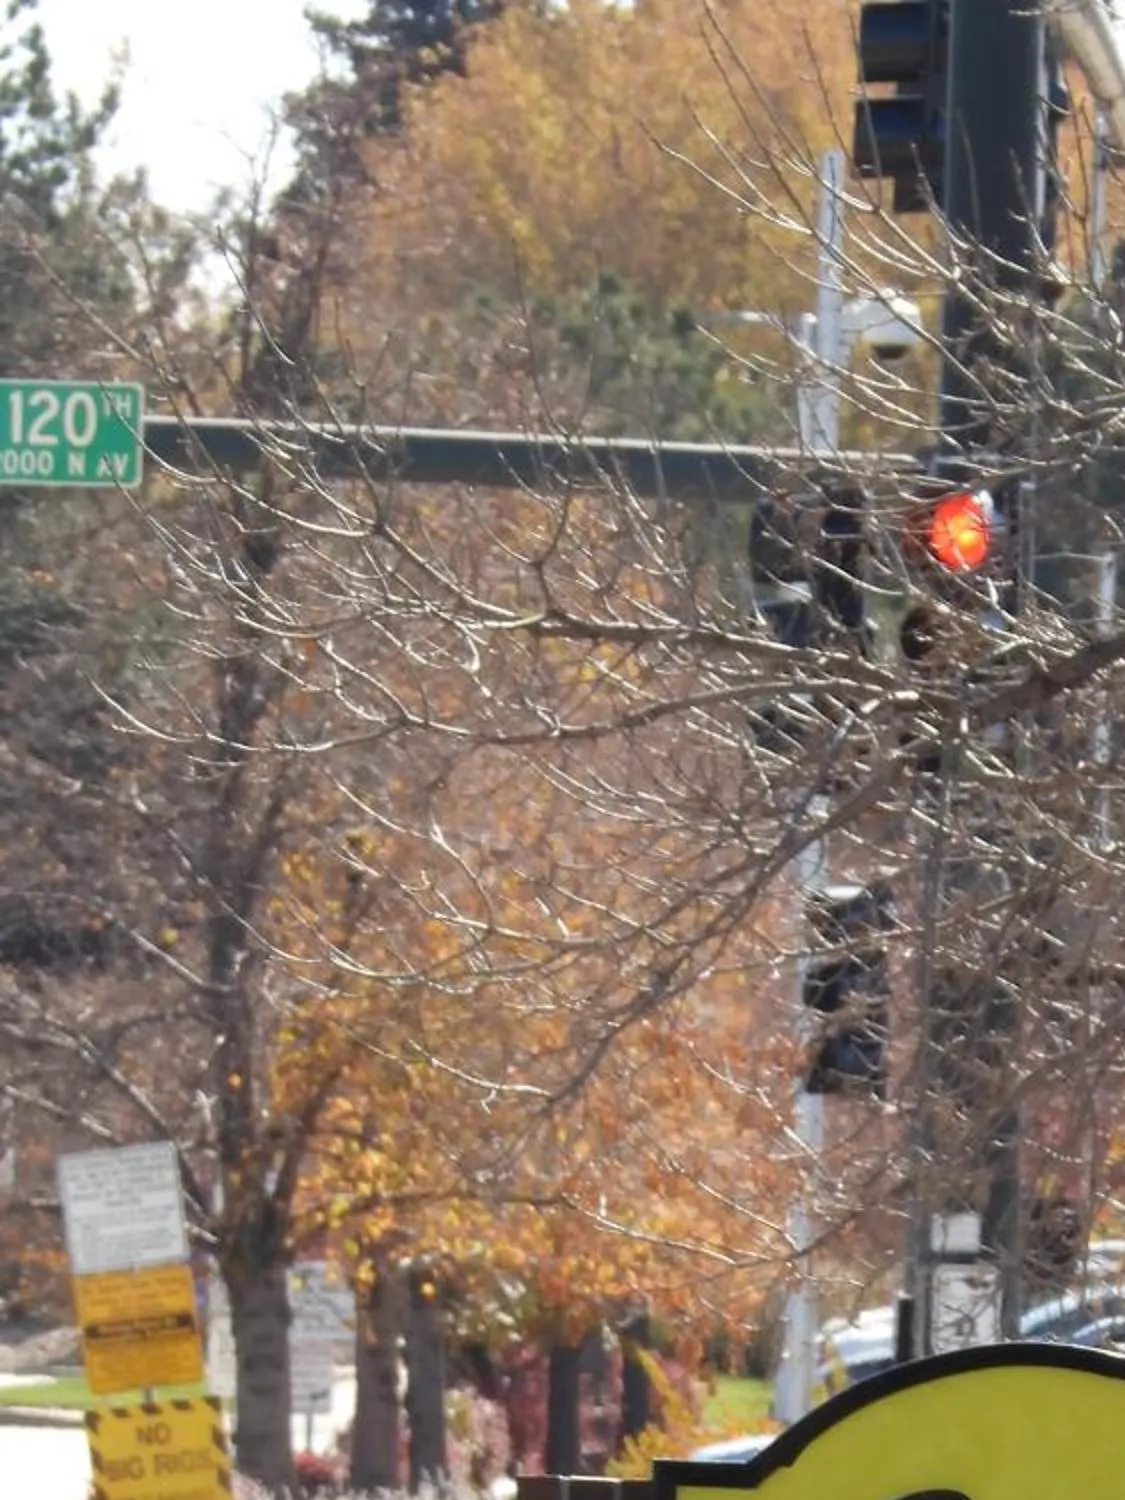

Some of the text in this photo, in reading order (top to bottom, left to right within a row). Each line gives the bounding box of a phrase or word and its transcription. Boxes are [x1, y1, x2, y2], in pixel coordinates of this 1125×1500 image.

[0, 448, 129, 478] 000 N AV
[135, 1421, 172, 1446] NO
